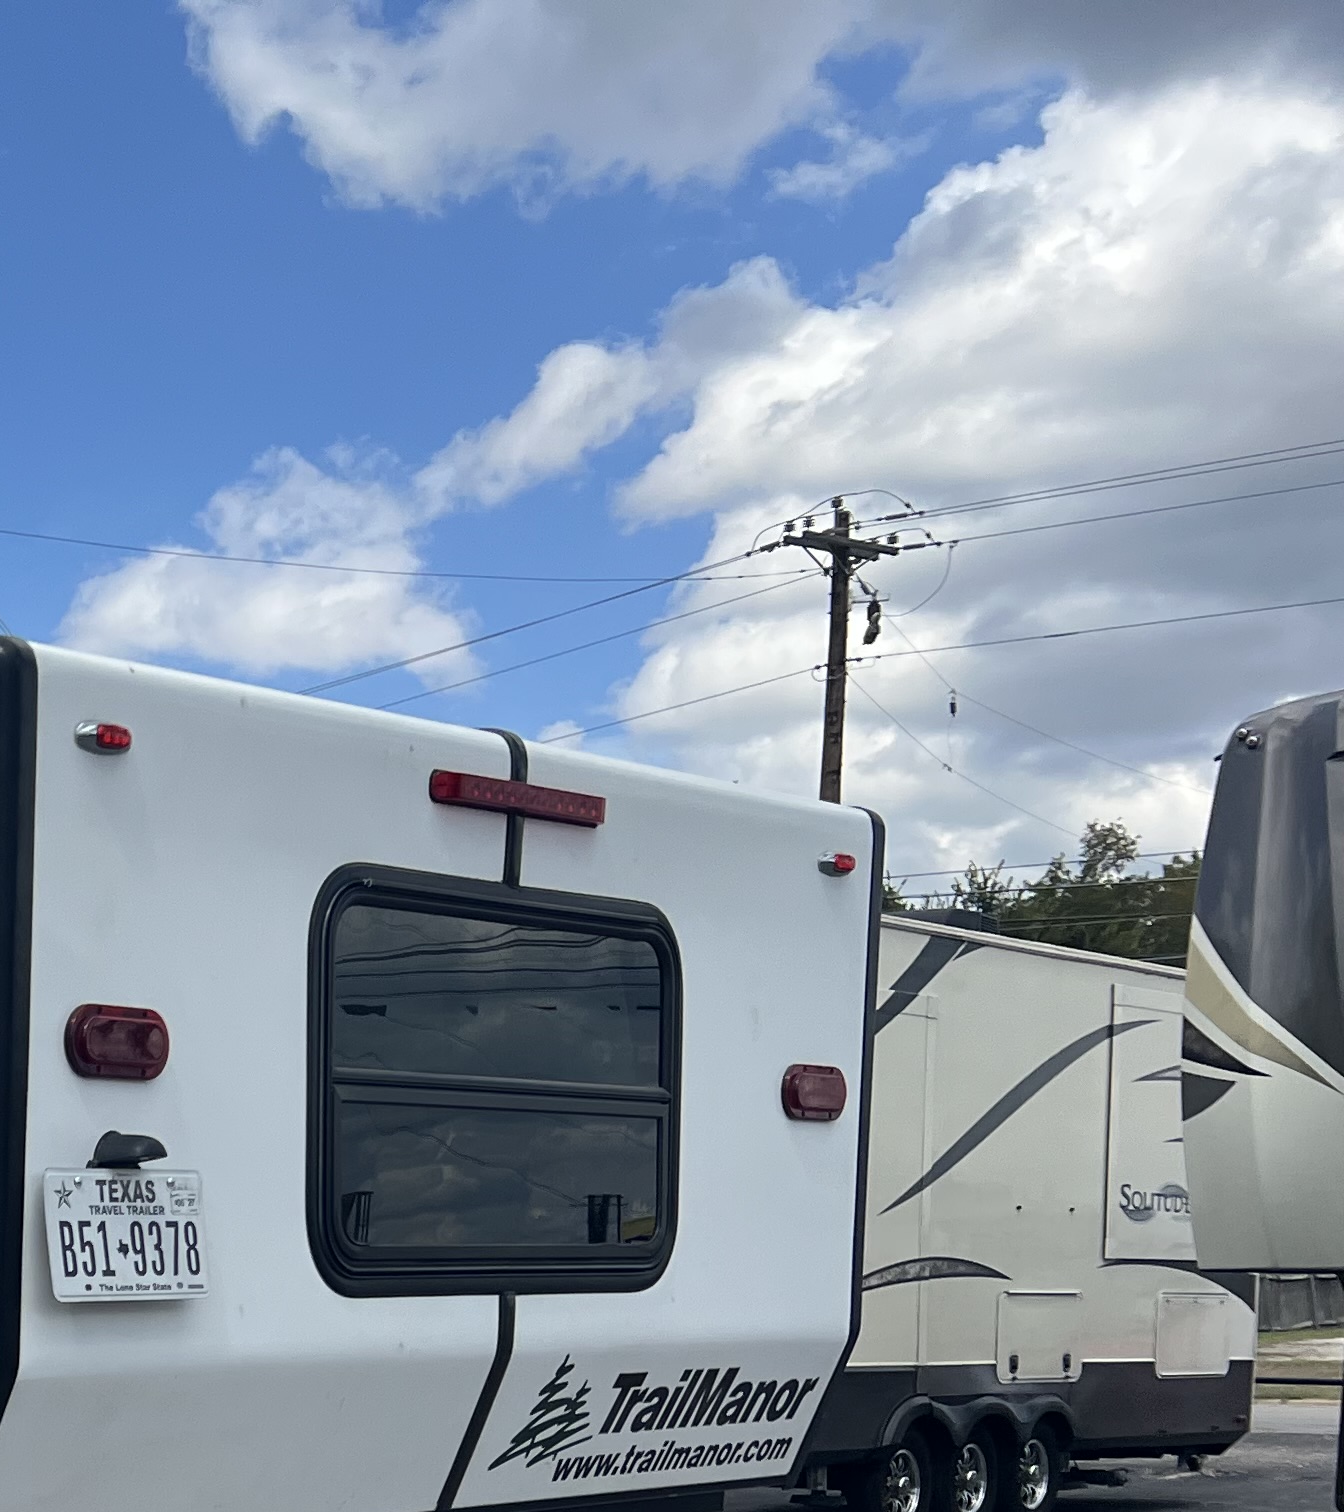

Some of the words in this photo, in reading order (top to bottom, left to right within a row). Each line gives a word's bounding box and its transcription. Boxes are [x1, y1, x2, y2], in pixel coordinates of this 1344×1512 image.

[95, 1179, 156, 1204] TEXAS
[88, 1205, 124, 1216] TRAVEL
[126, 1205, 165, 1216] TRAILER
[598, 1367, 820, 1434] TrailManor
[551, 1437, 793, 1482] www.trailmanor.com
